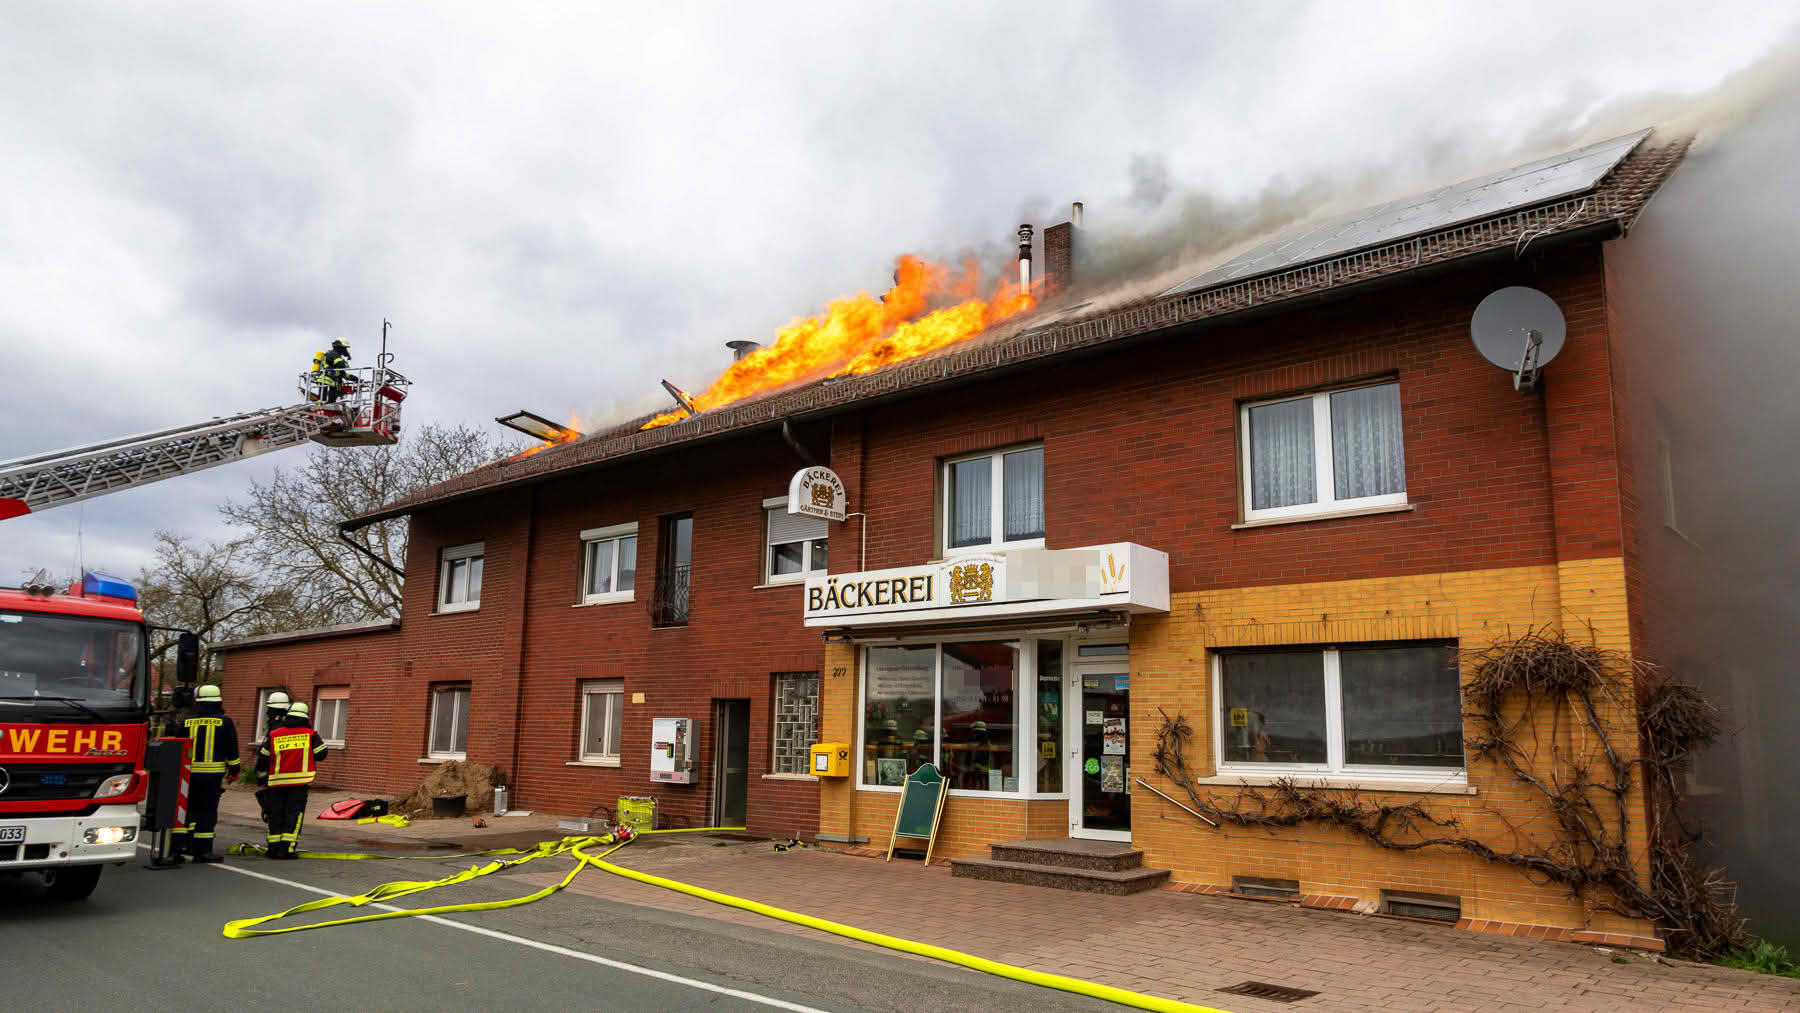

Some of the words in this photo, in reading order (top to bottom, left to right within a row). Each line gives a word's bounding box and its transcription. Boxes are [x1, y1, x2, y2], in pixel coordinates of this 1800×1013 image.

[803, 471, 842, 496] BÄCKEREI
[808, 573, 934, 612] BÄCKEREI
[9, 729, 122, 753] WEHR
